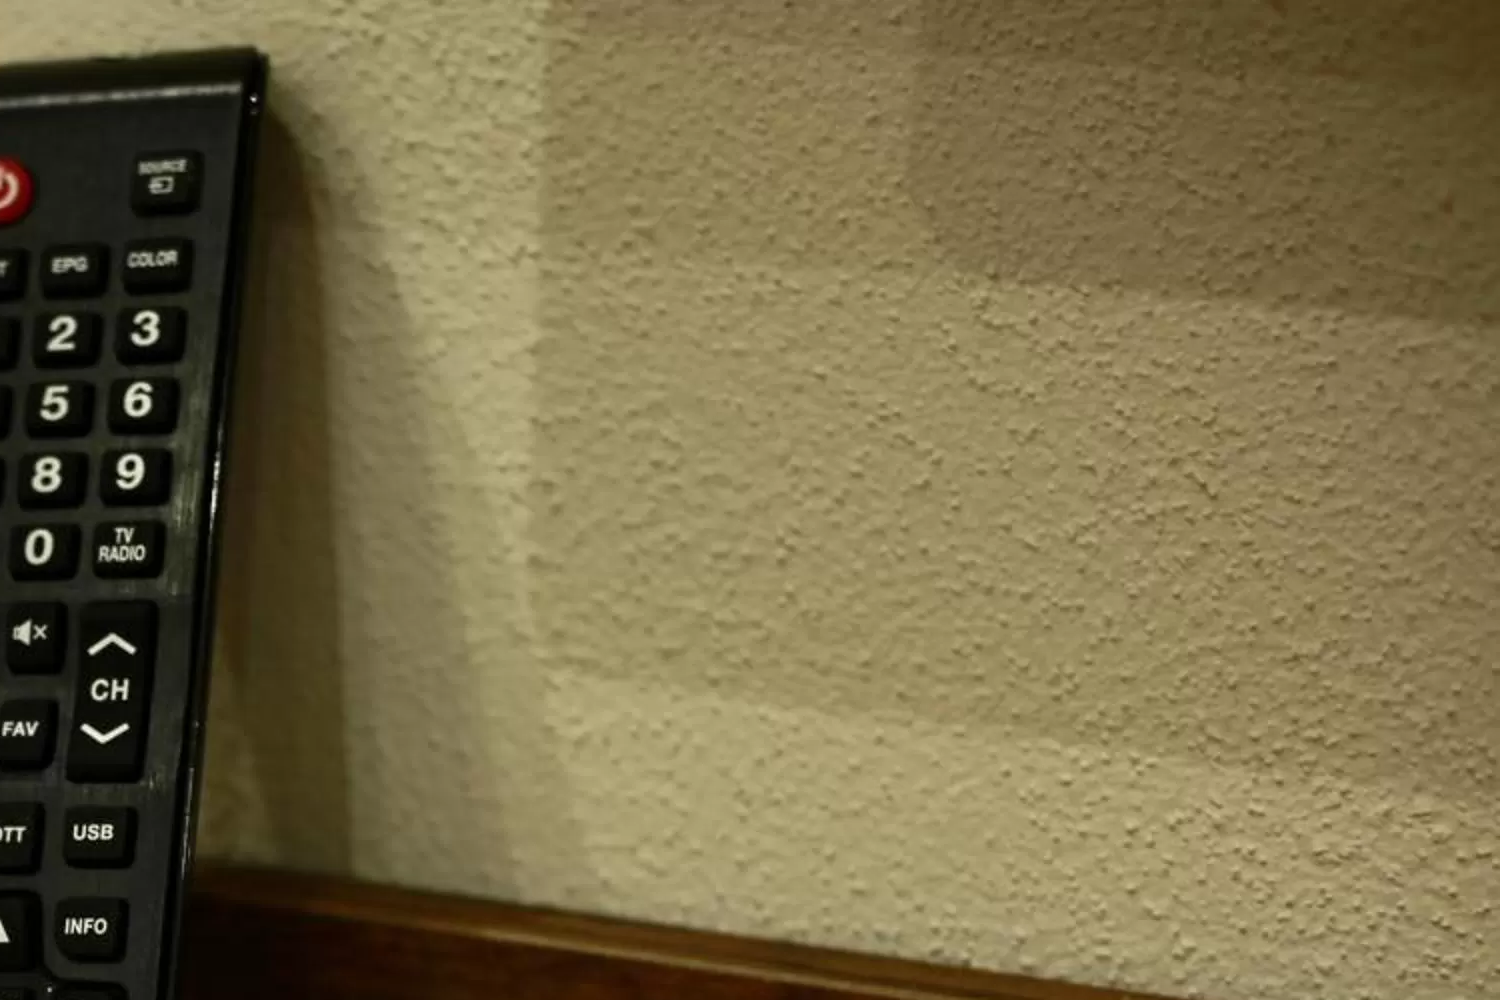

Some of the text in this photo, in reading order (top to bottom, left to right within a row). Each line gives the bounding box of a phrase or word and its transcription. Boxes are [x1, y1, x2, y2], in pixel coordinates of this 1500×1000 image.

[51, 255, 89, 274] EPG
[127, 249, 179, 269] COLOR
[46, 315, 78, 352] 2
[130, 309, 160, 347] 3
[39, 384, 69, 422] 5
[123, 381, 153, 418] 6
[31, 456, 62, 493] 8
[115, 453, 145, 490] 9
[24, 528, 54, 566] 0
[114, 526, 135, 544] TV
[98, 543, 147, 563] RADIO
[90, 678, 130, 702] CH
[1, 720, 40, 737] FAV
[72, 823, 114, 841] USB
[64, 917, 108, 935] INFO
